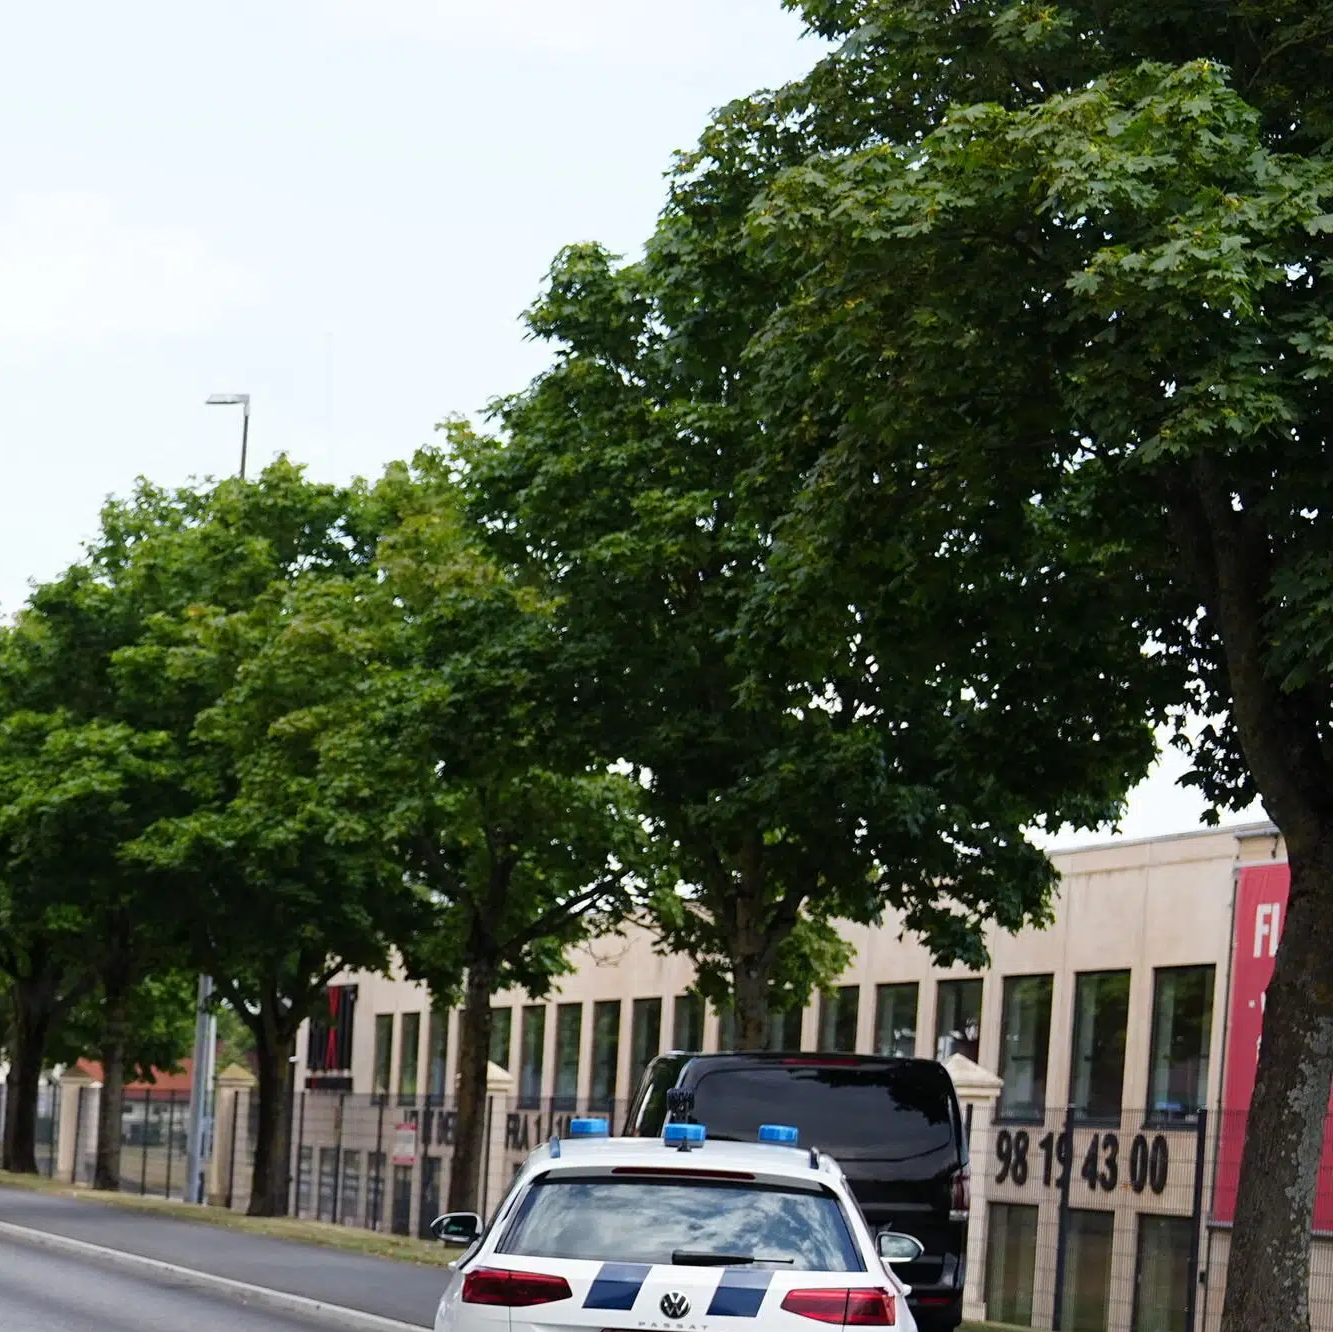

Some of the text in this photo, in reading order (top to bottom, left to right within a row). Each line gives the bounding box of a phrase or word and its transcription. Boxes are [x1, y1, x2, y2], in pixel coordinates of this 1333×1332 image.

[995, 1130, 1029, 1186] 98
[1081, 1133, 1119, 1191] 43
[1130, 1134, 1169, 1194] 00
[638, 1322, 709, 1330] PASSAT
